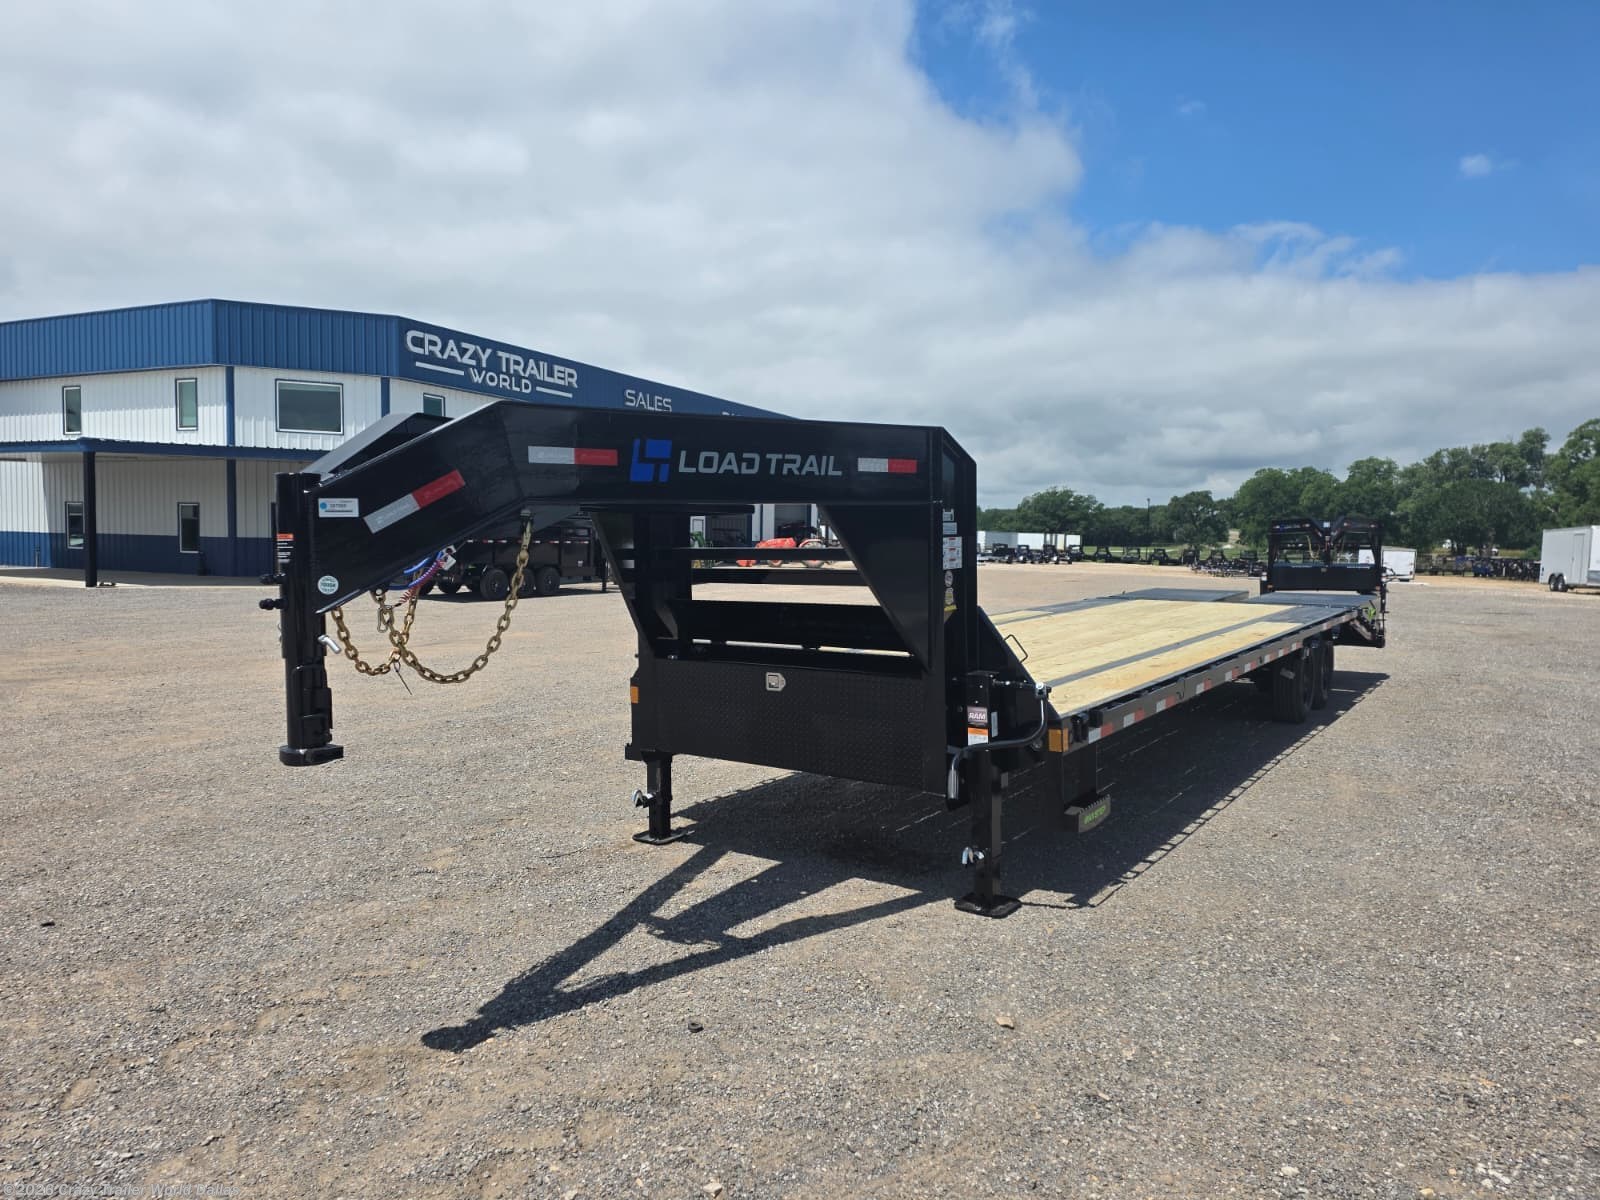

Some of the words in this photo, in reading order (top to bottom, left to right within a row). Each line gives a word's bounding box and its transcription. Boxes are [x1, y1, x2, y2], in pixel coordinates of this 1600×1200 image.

[406, 329, 492, 368] CRAZY
[496, 350, 578, 389] TRAILER
[469, 367, 532, 394] WORLD
[624, 389, 673, 412] SALES
[678, 449, 761, 476] LOAD
[766, 453, 843, 477] TRAIL
[968, 711, 987, 721] RAM
